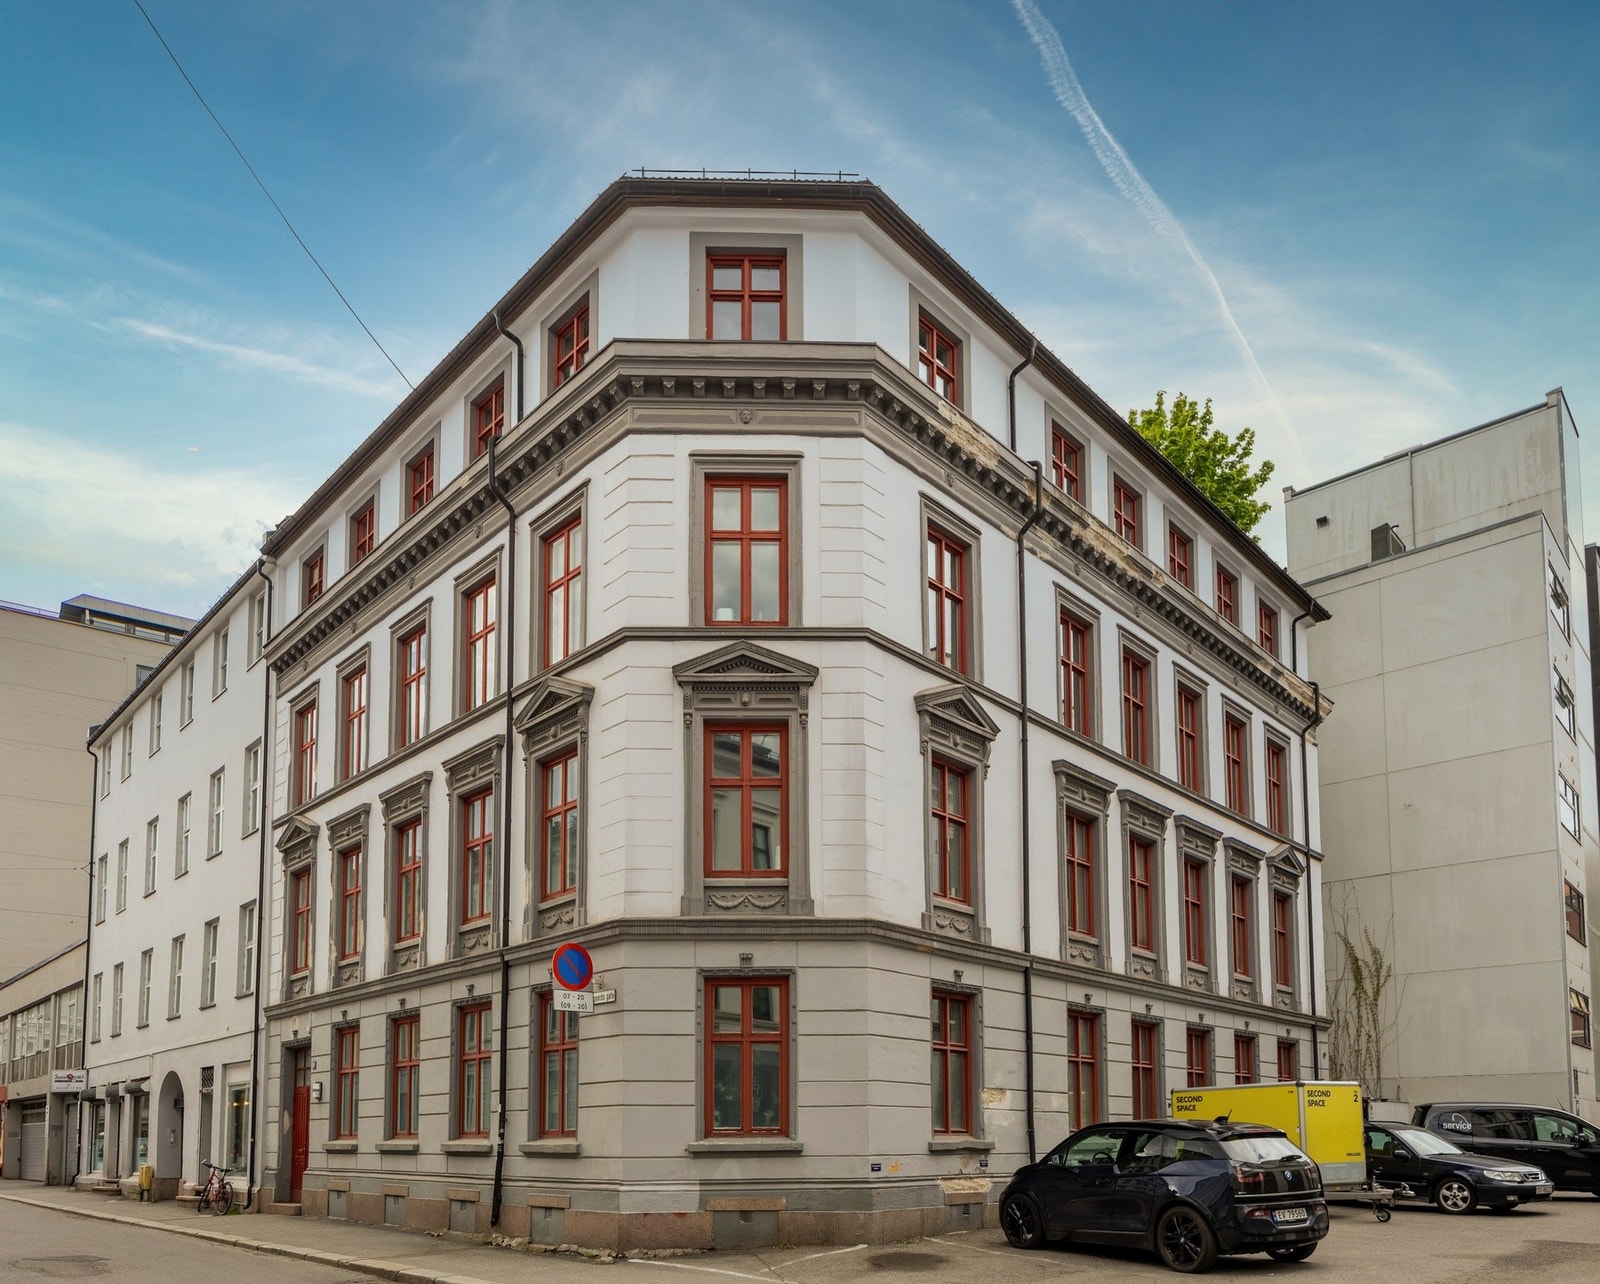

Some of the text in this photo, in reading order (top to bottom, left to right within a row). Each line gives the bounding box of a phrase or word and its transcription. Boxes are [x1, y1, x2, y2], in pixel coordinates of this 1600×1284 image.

[561, 1001, 570, 1009] (09
[1307, 1089, 1331, 1097] SECOND
[1176, 1095, 1203, 1103] SECOND
[1354, 1094, 1359, 1102] 2
[1307, 1099, 1326, 1107] SPACE
[1177, 1104, 1197, 1112] SPACE
[1442, 1121, 1472, 1130] service
[1277, 1211, 1286, 1220] EV
